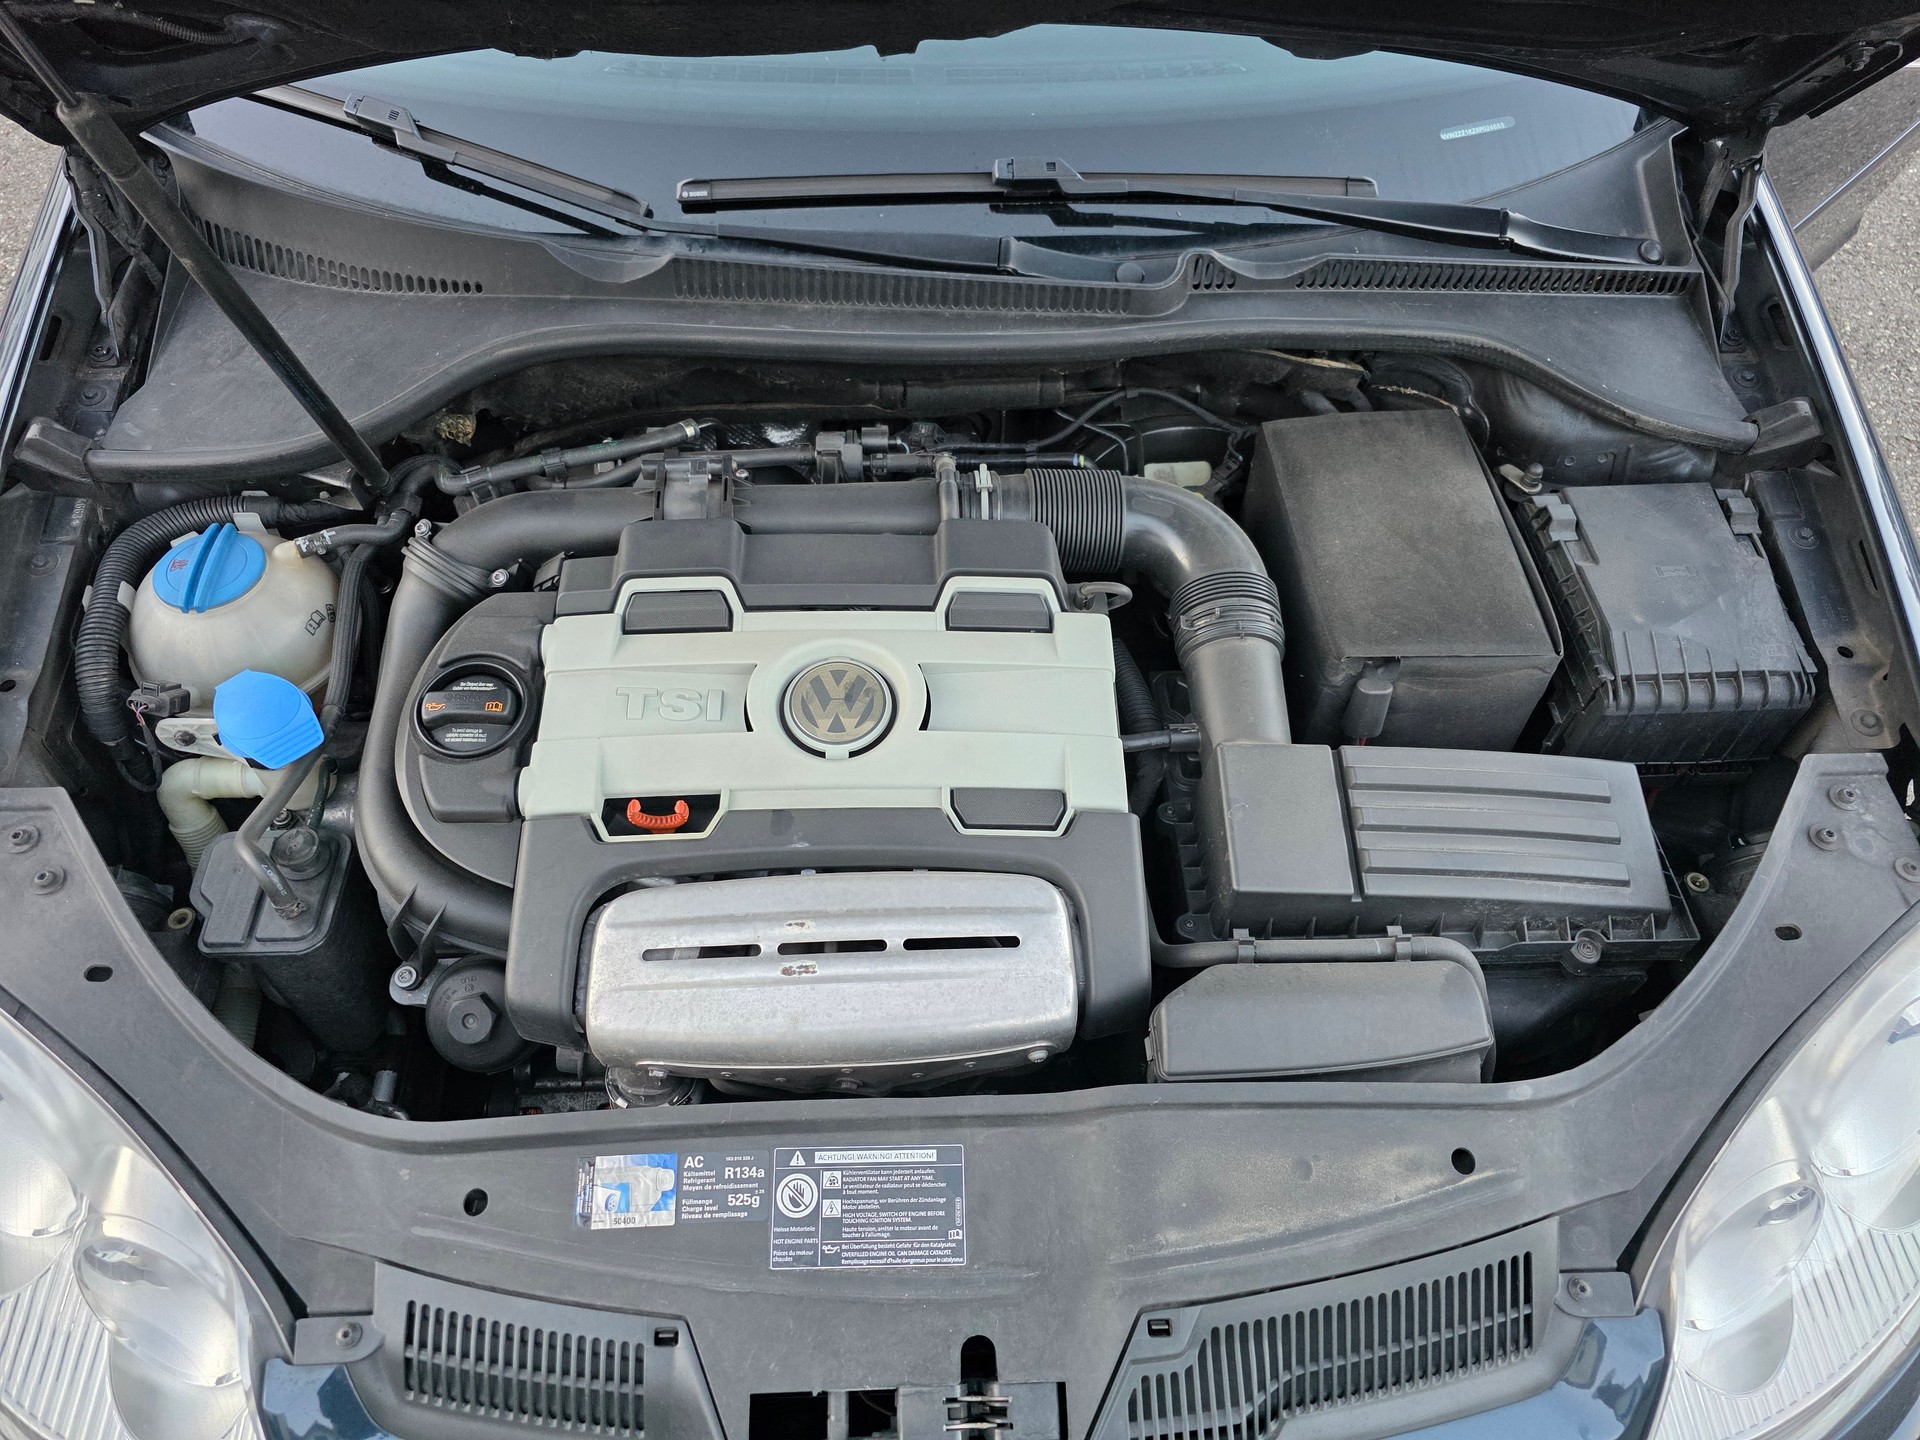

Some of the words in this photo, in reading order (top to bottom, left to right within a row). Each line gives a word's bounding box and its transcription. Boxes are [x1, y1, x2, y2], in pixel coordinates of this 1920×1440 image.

[616, 687, 724, 722] TSI
[684, 1156, 704, 1168] AC
[725, 1166, 765, 1179] R134a
[728, 1194, 760, 1208] 525g
